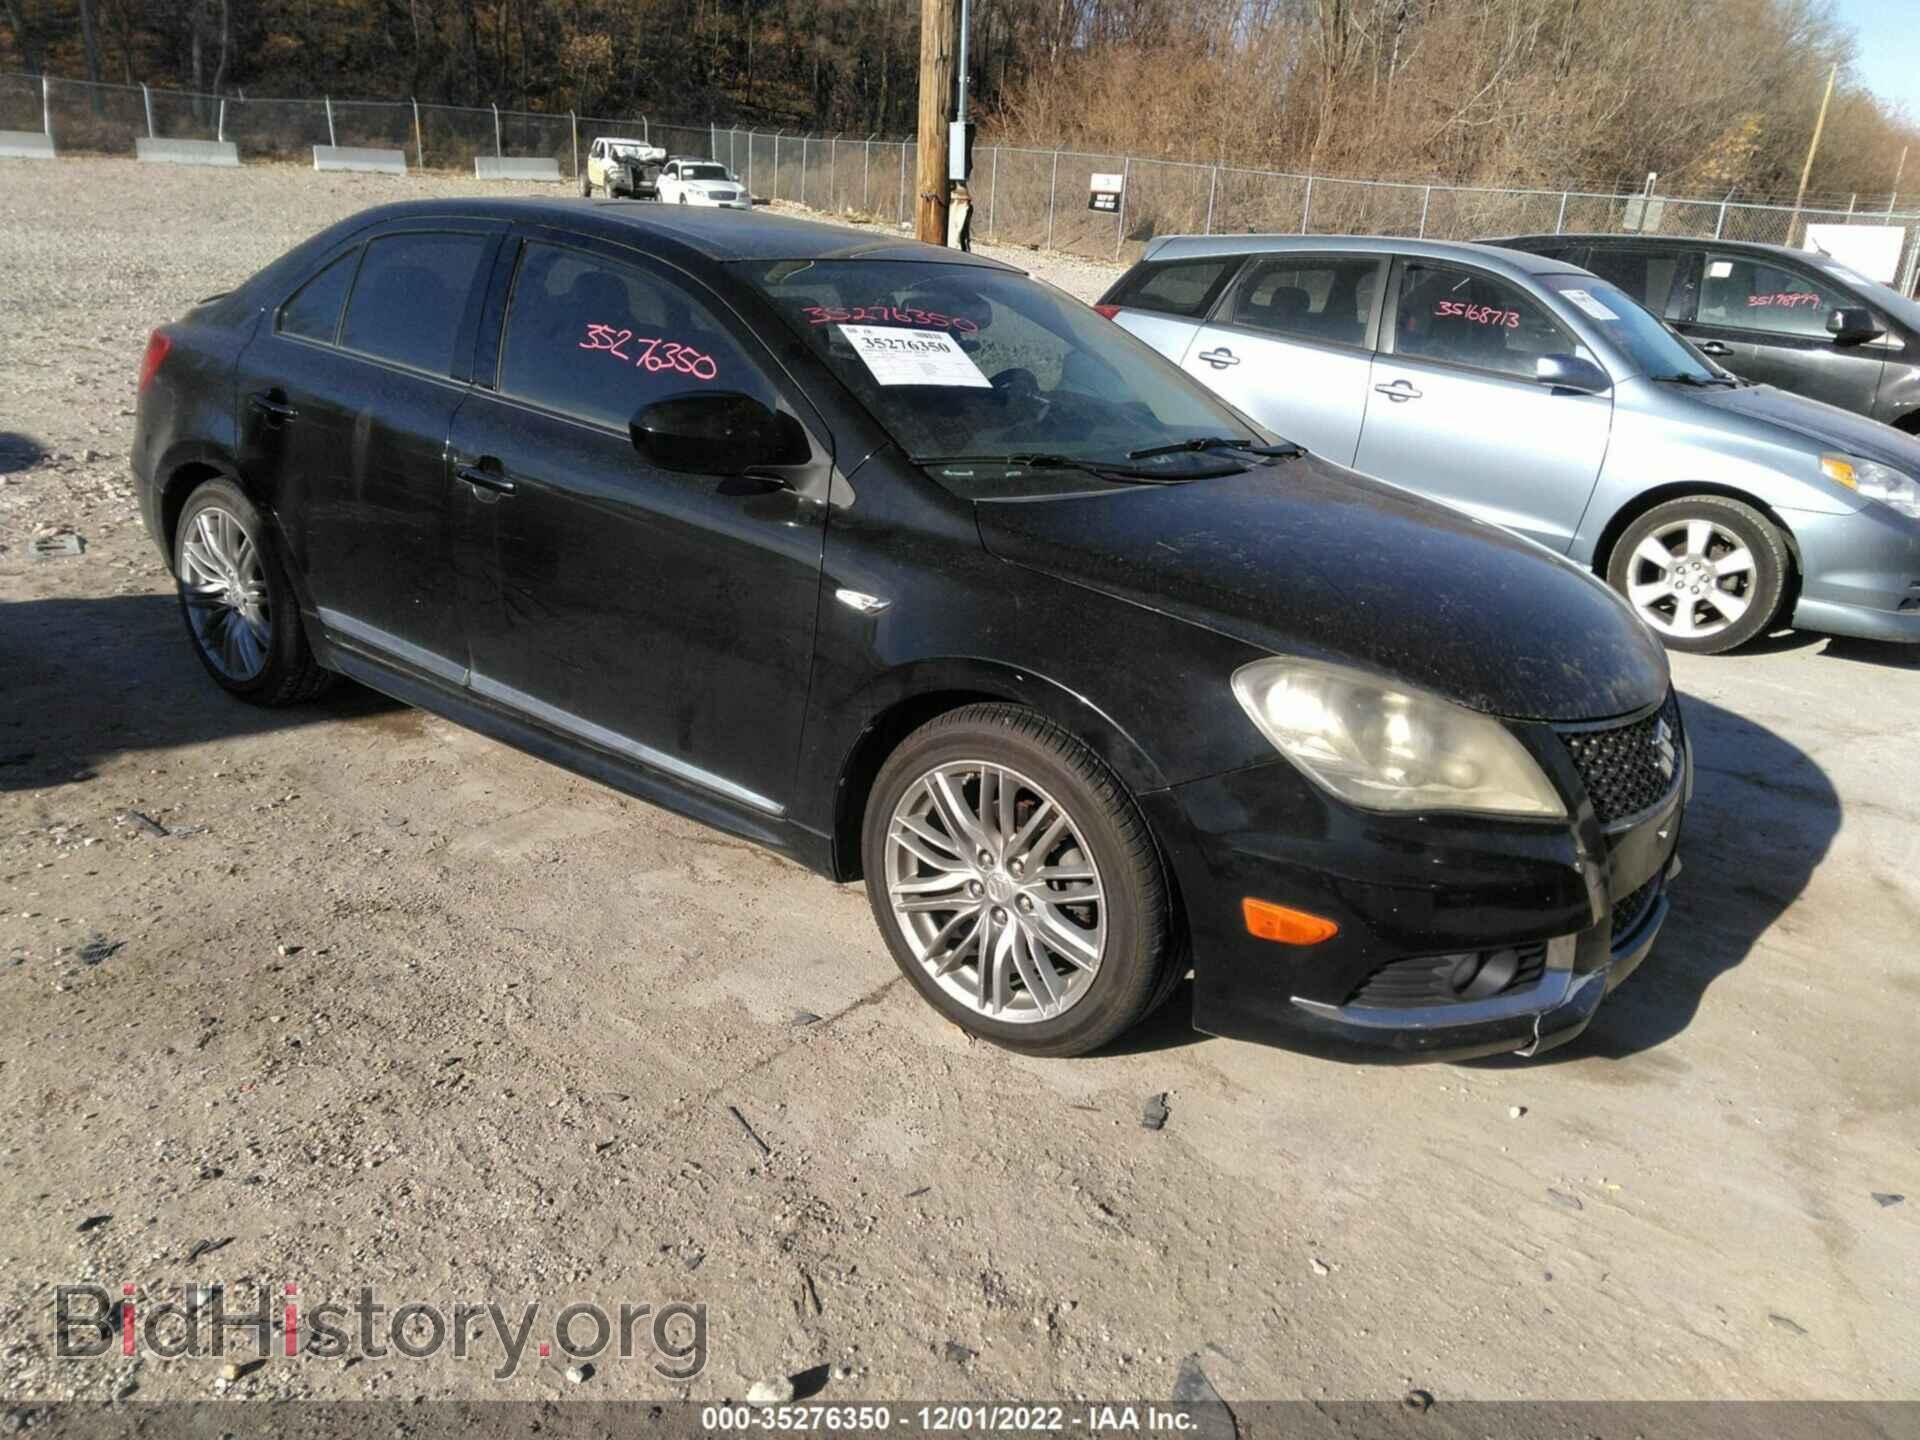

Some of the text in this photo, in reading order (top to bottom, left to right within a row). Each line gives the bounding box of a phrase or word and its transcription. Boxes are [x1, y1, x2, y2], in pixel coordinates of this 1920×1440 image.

[801, 305, 979, 335] 35276350
[1435, 301, 1520, 328] 35168713
[579, 323, 717, 380] 35276350
[862, 337, 951, 353] 35276350
